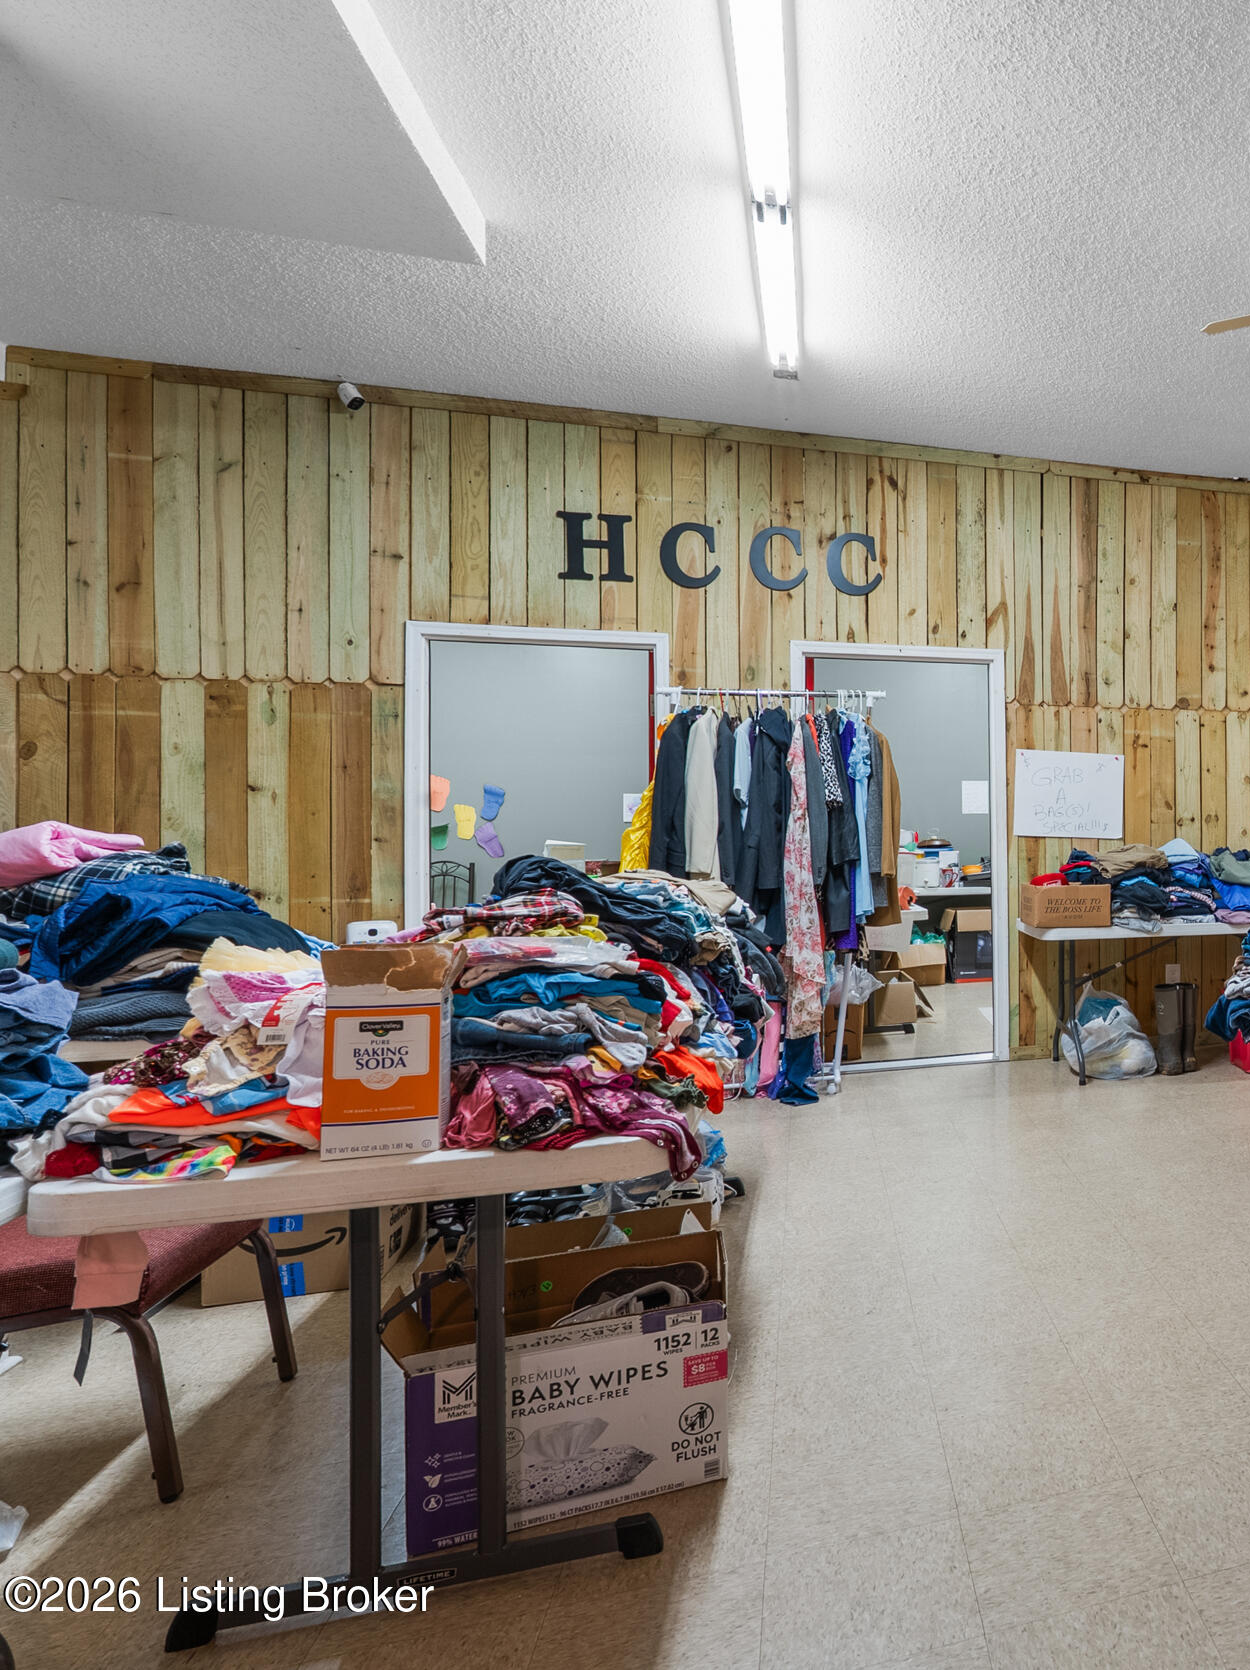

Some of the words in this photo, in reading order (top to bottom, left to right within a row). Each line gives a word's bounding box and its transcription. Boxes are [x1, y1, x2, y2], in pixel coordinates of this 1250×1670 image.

[1031, 766, 1085, 787] GRAB
[1055, 787, 1067, 804] A
[1047, 898, 1088, 906] WELCOME
[1062, 905, 1083, 913] BOSS
[1083, 905, 1103, 913] LIFE
[353, 1045, 409, 1058] BAKING
[355, 1056, 407, 1071] SODA
[654, 1332, 692, 1351] 1152
[701, 1327, 720, 1343] 12
[700, 1340, 720, 1348] PACKS
[663, 1348, 683, 1356] WIPES
[511, 1366, 577, 1387] PREMIUM
[691, 1363, 706, 1375] $8
[511, 1377, 581, 1407] BABY
[589, 1360, 669, 1391] WIPES
[511, 1387, 630, 1419] FRAGRANCE-FREE
[671, 1438, 691, 1452] DO
[694, 1430, 722, 1447] NOT
[676, 1444, 717, 1463] FLUSH
[574, 1503, 592, 1514] PACKS
[454, 1531, 478, 1543] WATER
[403, 1570, 451, 1585] LIFETIME
